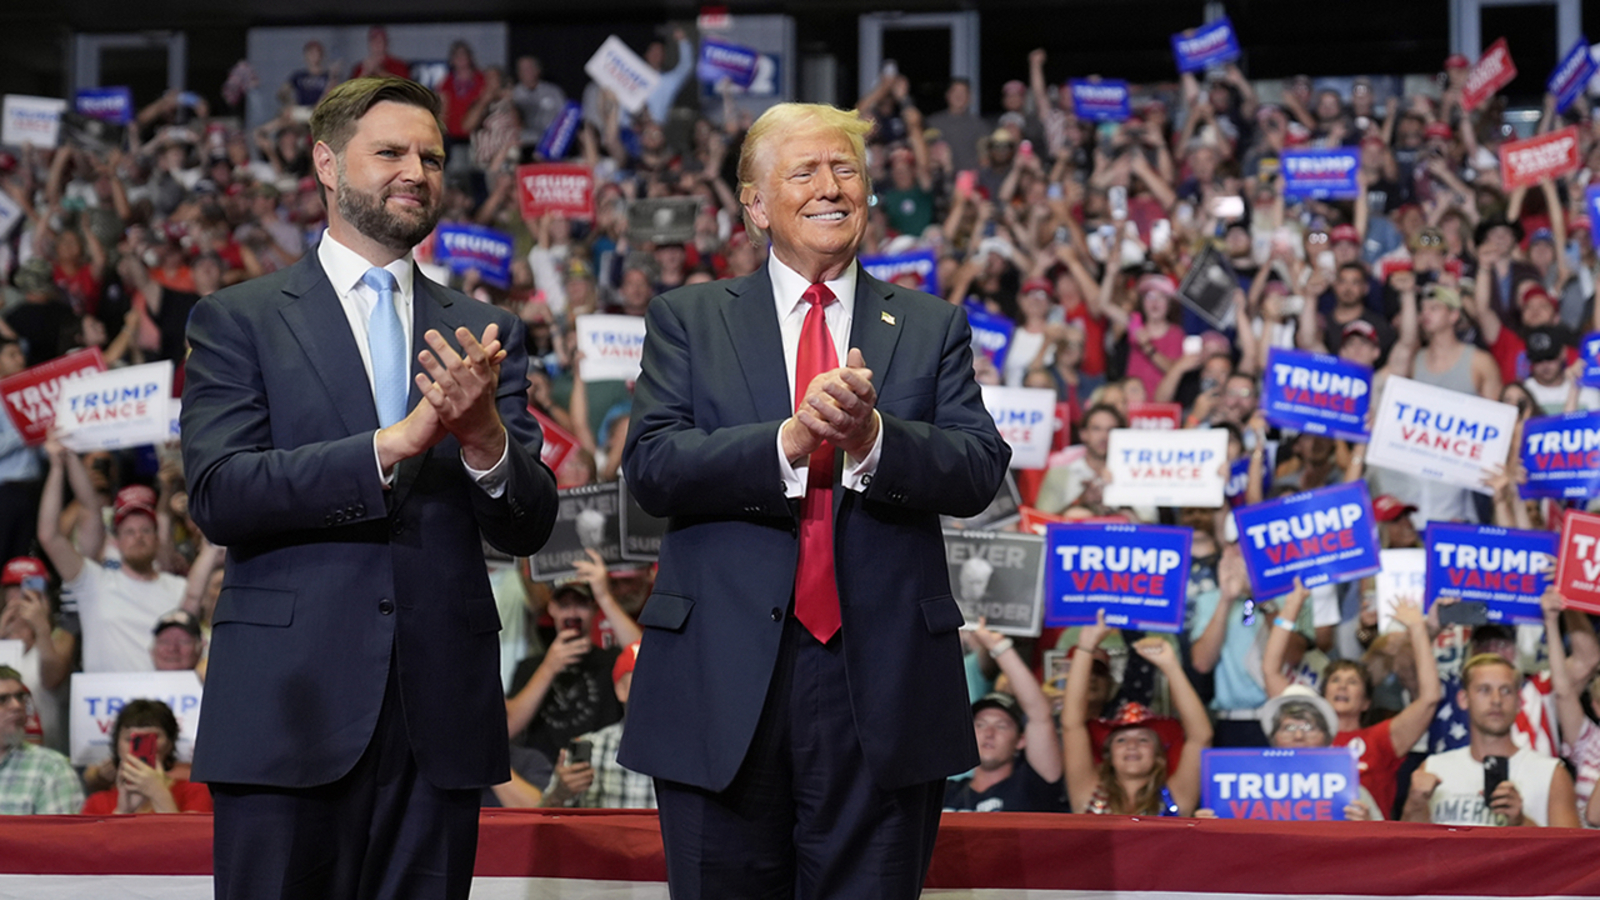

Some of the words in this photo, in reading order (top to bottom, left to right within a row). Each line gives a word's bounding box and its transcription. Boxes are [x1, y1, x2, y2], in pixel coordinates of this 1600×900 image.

[523, 174, 589, 190] TRUMP
[440, 231, 510, 258] TRUMP
[589, 332, 646, 345] TRUM
[1273, 362, 1368, 399] TRUMP
[69, 382, 159, 411] TRUMP
[1282, 385, 1356, 414] VANCE
[76, 402, 148, 424] VANCE
[993, 411, 1043, 426] UMP
[1395, 401, 1500, 442] TRUMP
[1402, 425, 1484, 462] VANCE
[1527, 428, 1600, 456] TRUM
[1121, 449, 1214, 464] TRUMP
[1534, 450, 1600, 470] VANC
[1130, 466, 1202, 480] VANCE
[1246, 503, 1362, 550] TRUMP
[950, 543, 1027, 570] EVER
[1056, 544, 1181, 576] TRUMP
[1265, 528, 1356, 566] VANCE
[1434, 542, 1549, 576] TRUMP
[1070, 571, 1165, 596] VANCE
[1448, 567, 1536, 594] VANCE
[1213, 773, 1347, 800] TRUMP
[1229, 801, 1333, 821] VANCE
